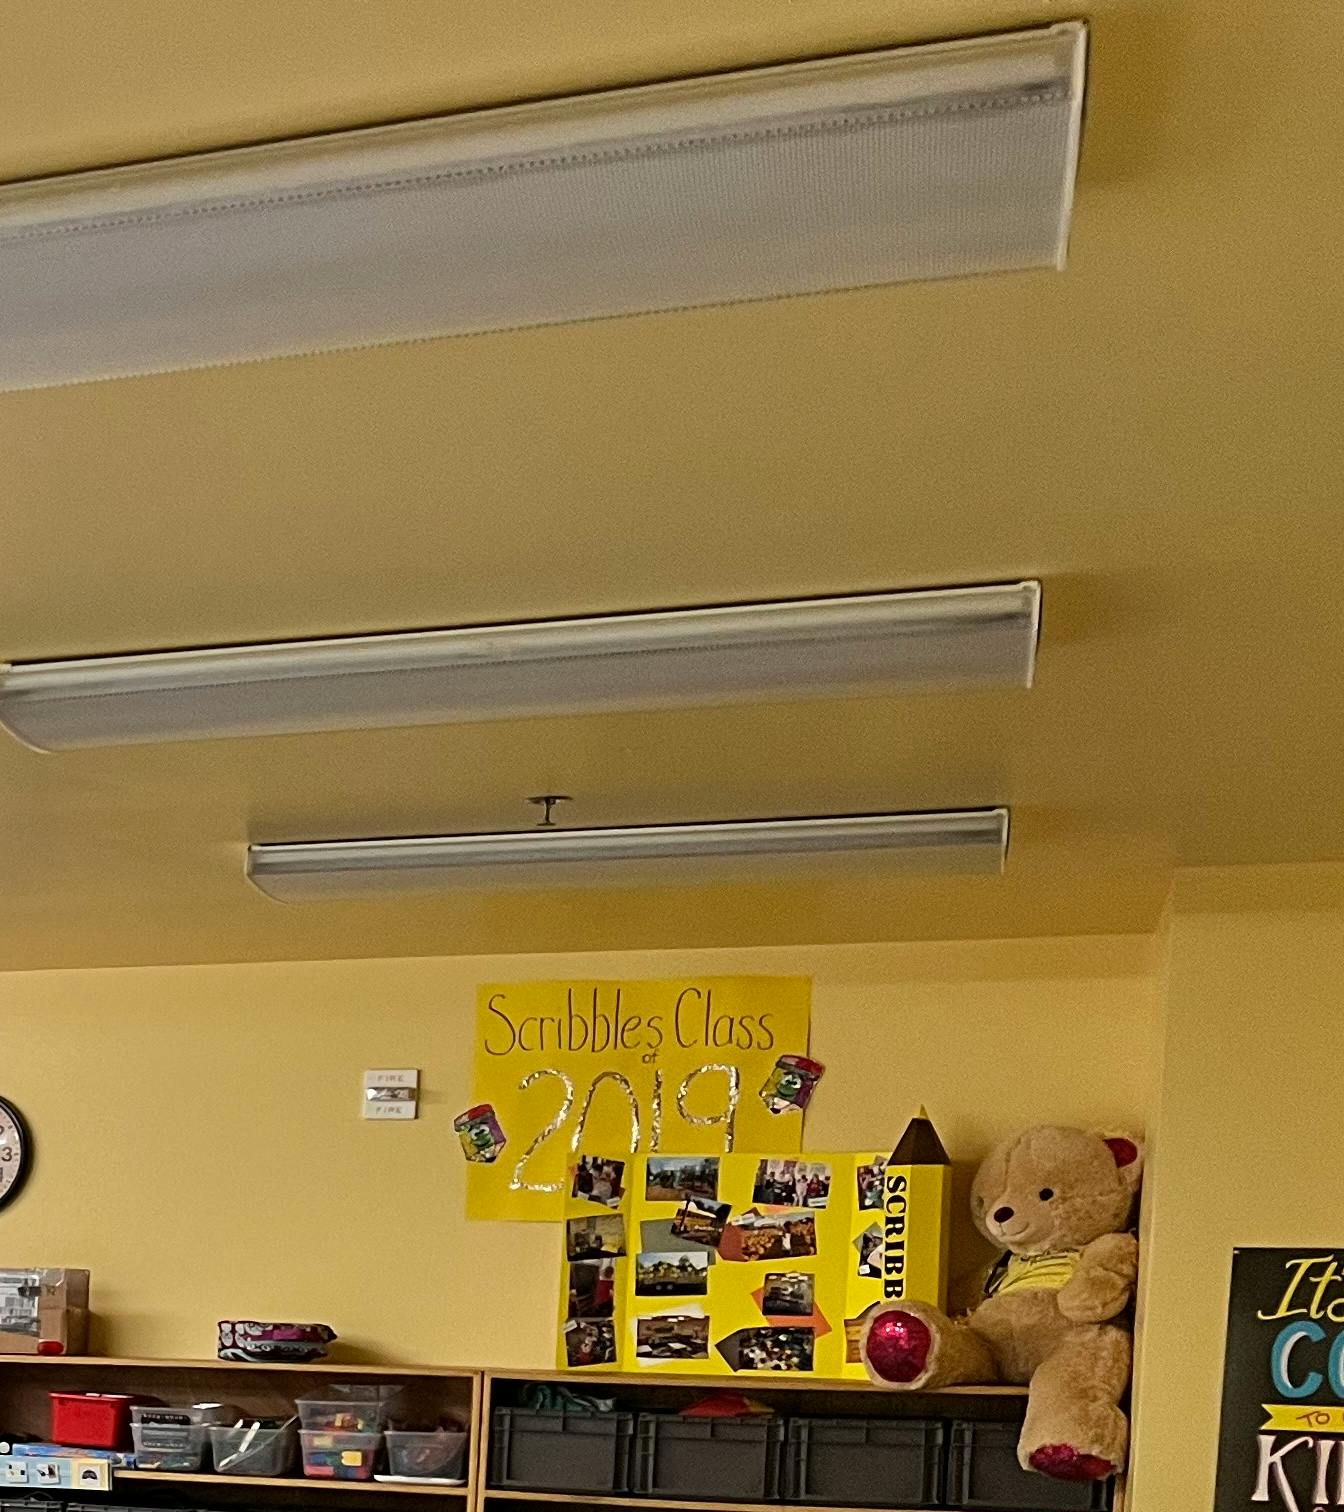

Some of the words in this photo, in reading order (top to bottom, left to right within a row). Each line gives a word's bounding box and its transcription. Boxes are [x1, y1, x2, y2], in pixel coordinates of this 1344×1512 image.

[484, 987, 664, 1056] Scribbles
[675, 987, 775, 1052] Class
[641, 1049, 660, 1065] of
[509, 1062, 741, 1192] 2019
[1, 1146, 13, 1162] 3
[1296, 1410, 1331, 1425] TO
